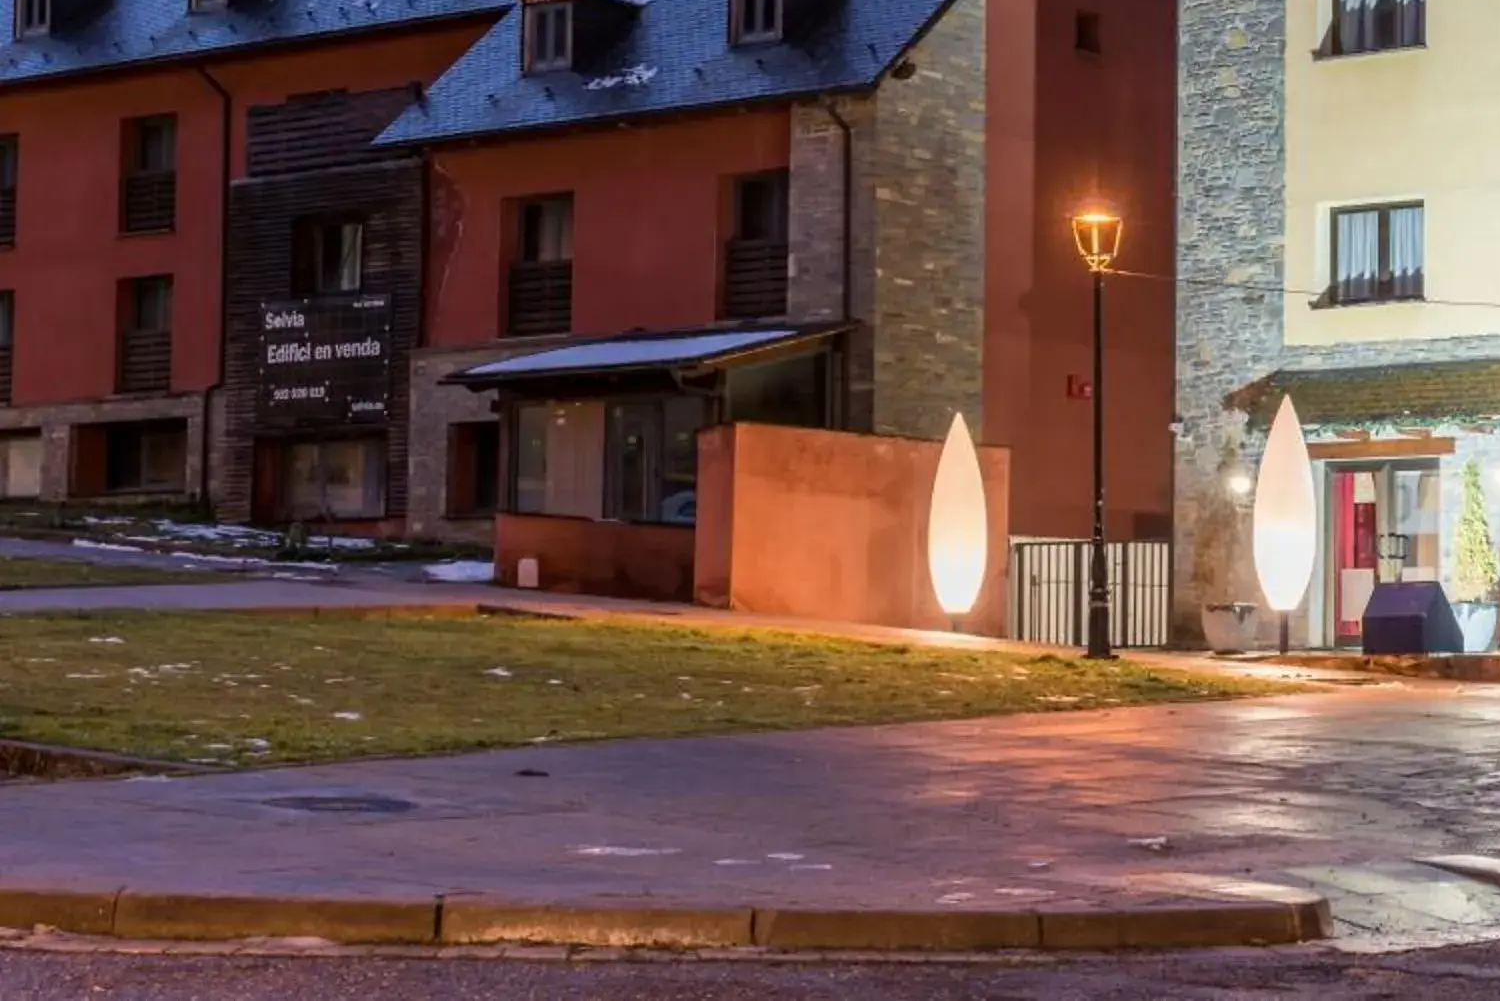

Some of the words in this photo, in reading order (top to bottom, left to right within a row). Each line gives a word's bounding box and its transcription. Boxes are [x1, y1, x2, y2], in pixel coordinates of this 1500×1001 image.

[267, 342, 311, 364] Edifici
[315, 345, 331, 360] en
[335, 336, 381, 358] venda
